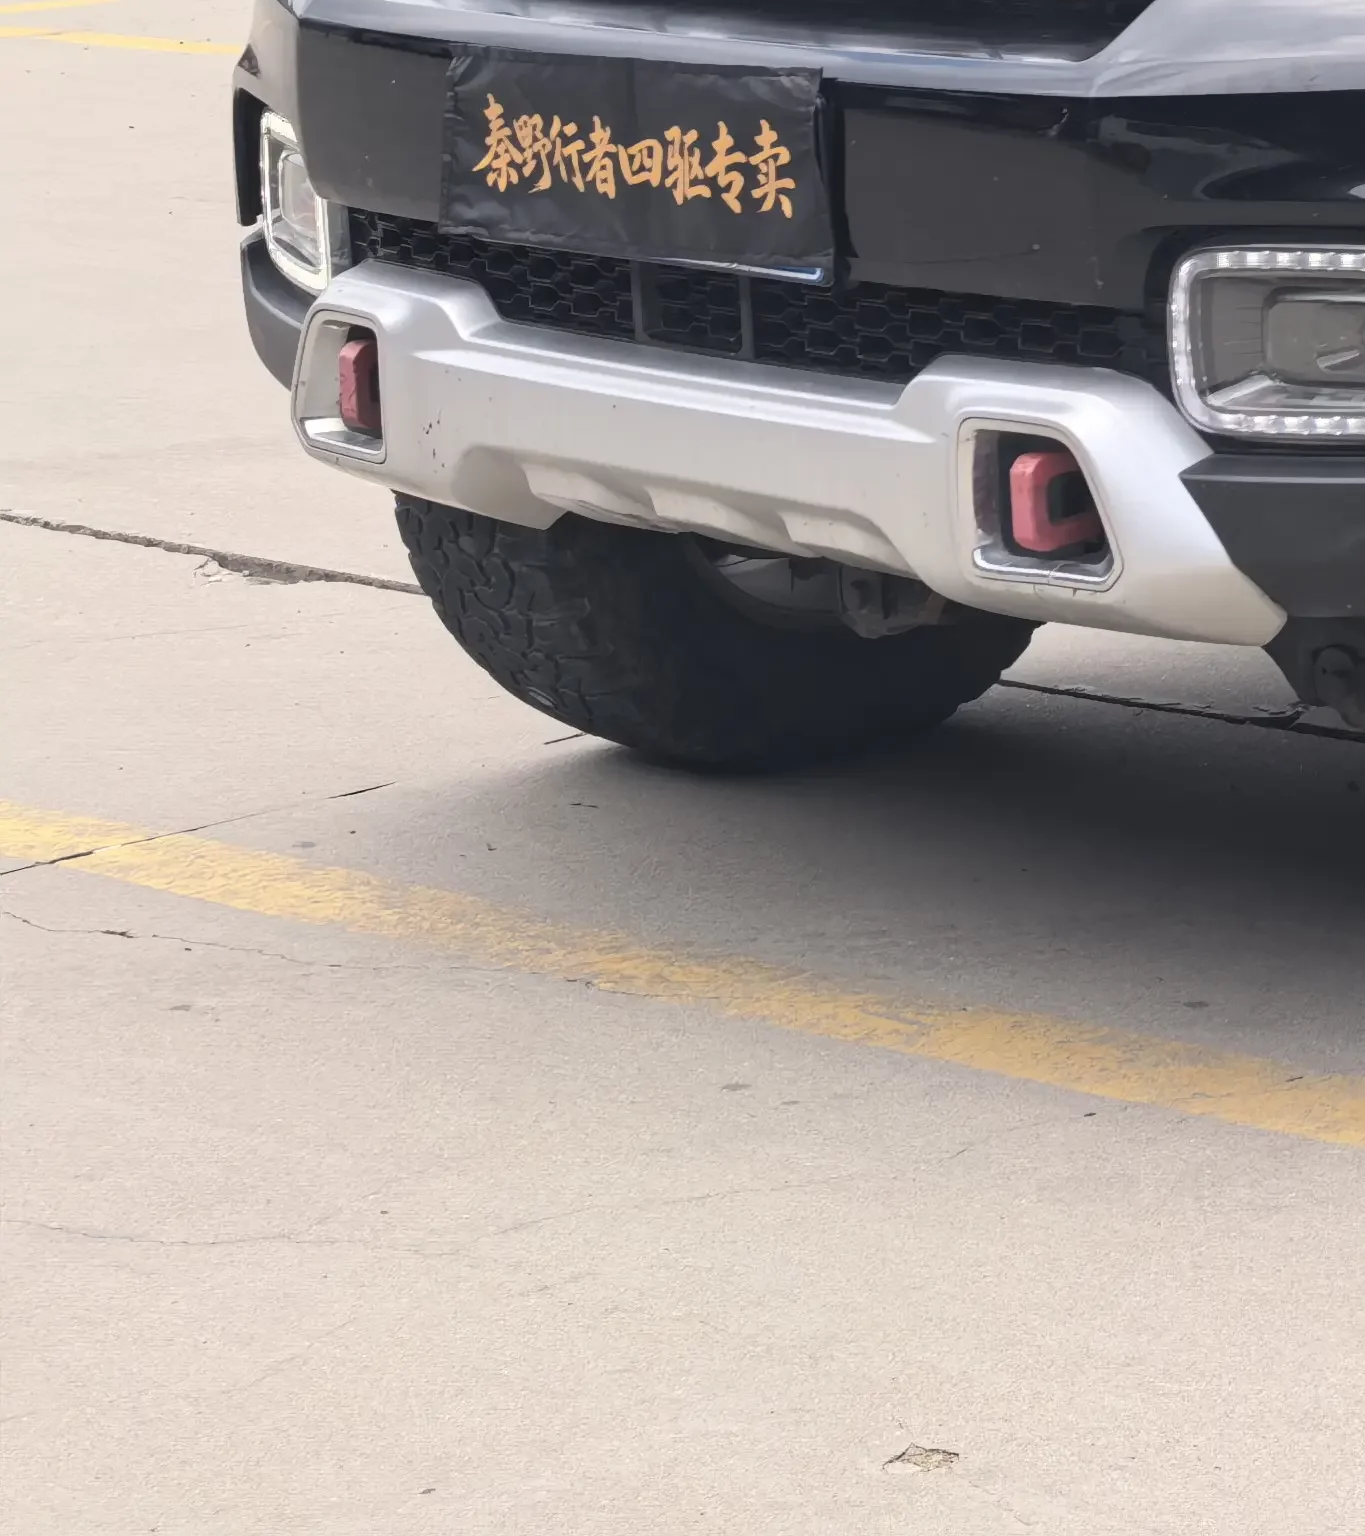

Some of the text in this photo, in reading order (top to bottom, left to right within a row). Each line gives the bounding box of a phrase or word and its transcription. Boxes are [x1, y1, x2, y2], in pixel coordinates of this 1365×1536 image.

[472, 93, 796, 219] 秦野行者四驱专卖
